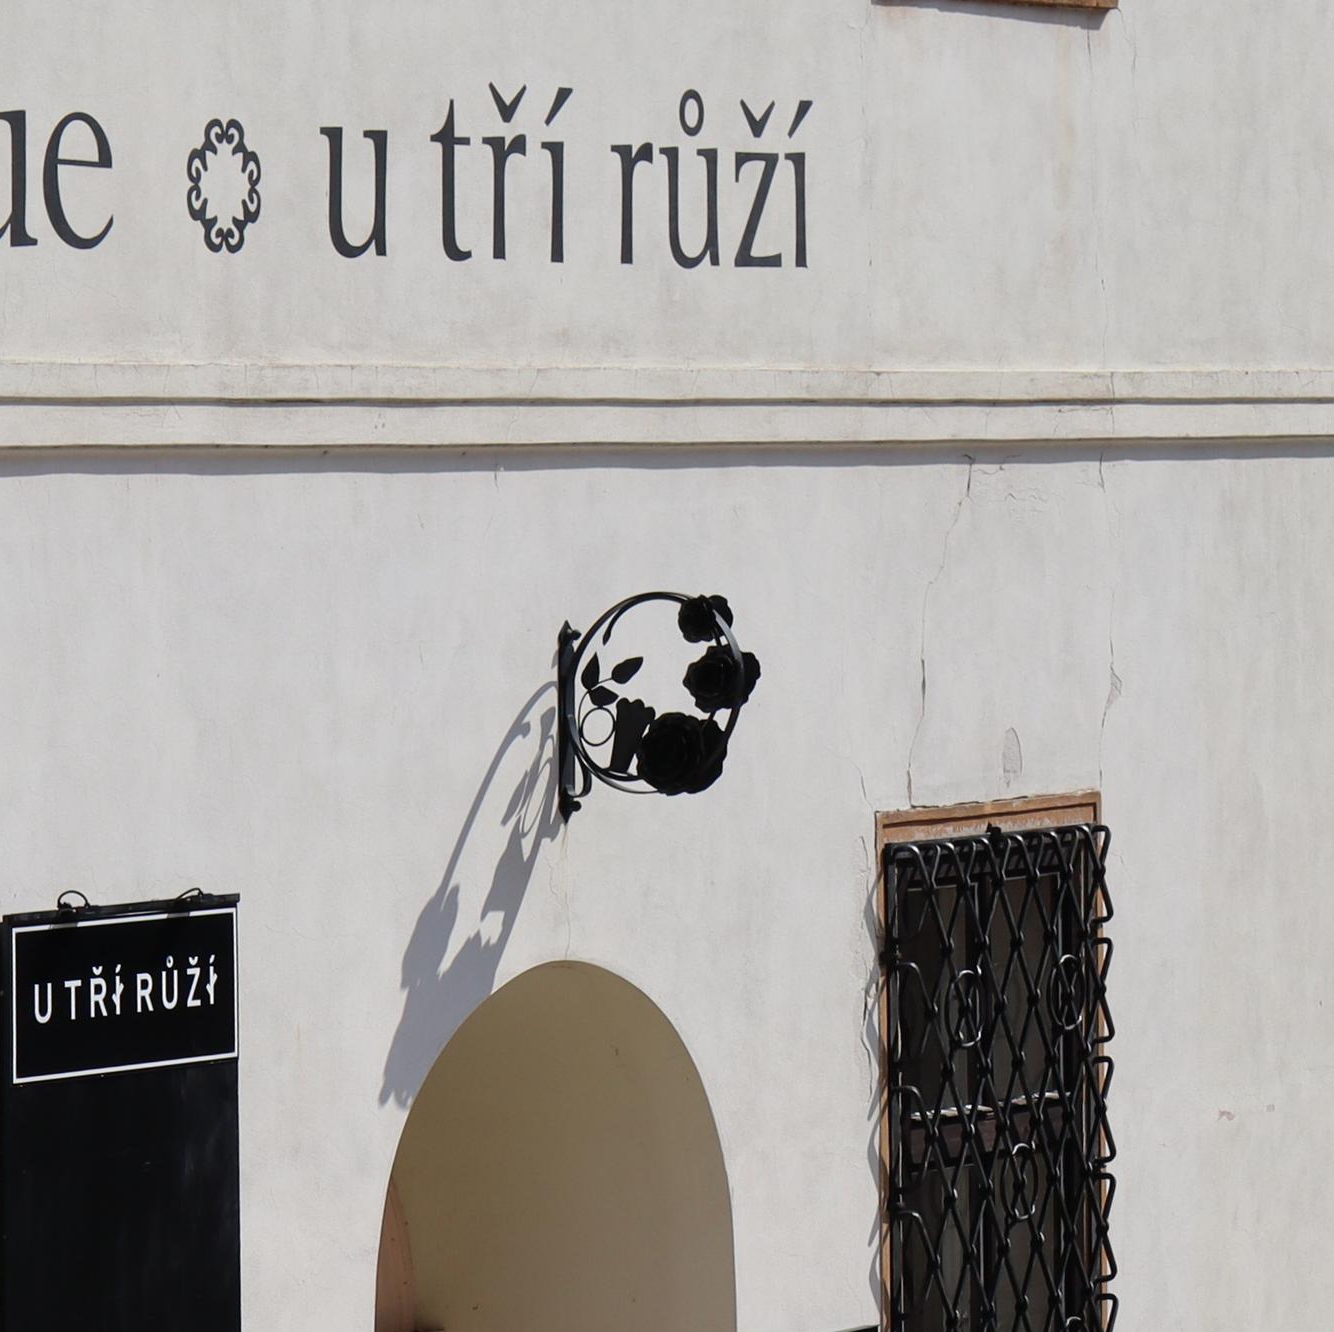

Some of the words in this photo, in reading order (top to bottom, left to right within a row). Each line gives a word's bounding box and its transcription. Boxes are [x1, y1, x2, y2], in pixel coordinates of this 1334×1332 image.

[320, 126, 388, 259] u
[430, 82, 573, 263] tří
[611, 89, 813, 269] růží
[33, 982, 53, 1025] U
[63, 963, 125, 1021] TŘÍ
[136, 954, 219, 1014] RŮŽÍ
